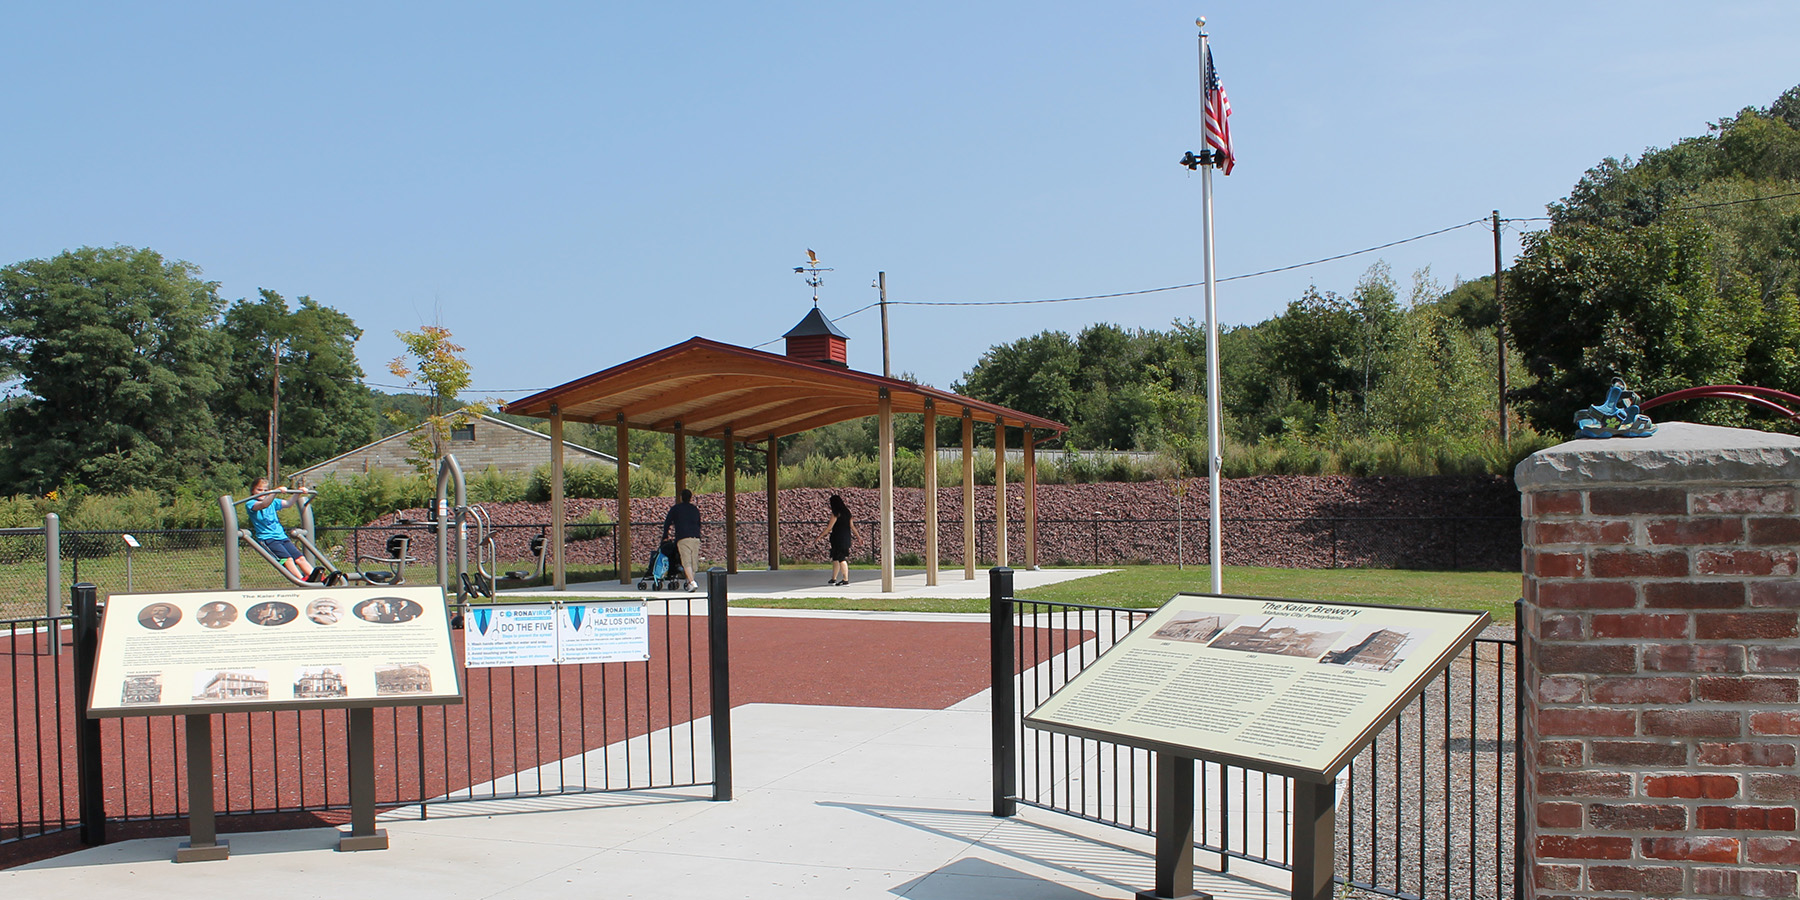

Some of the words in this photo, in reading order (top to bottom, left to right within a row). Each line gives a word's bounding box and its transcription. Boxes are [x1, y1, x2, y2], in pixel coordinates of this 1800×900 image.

[1262, 602, 1281, 610] The
[1282, 604, 1312, 612] Kaier
[1313, 606, 1361, 617] Brewery
[501, 624, 514, 632] DO
[516, 623, 533, 631] THE
[535, 622, 553, 631] FIVE
